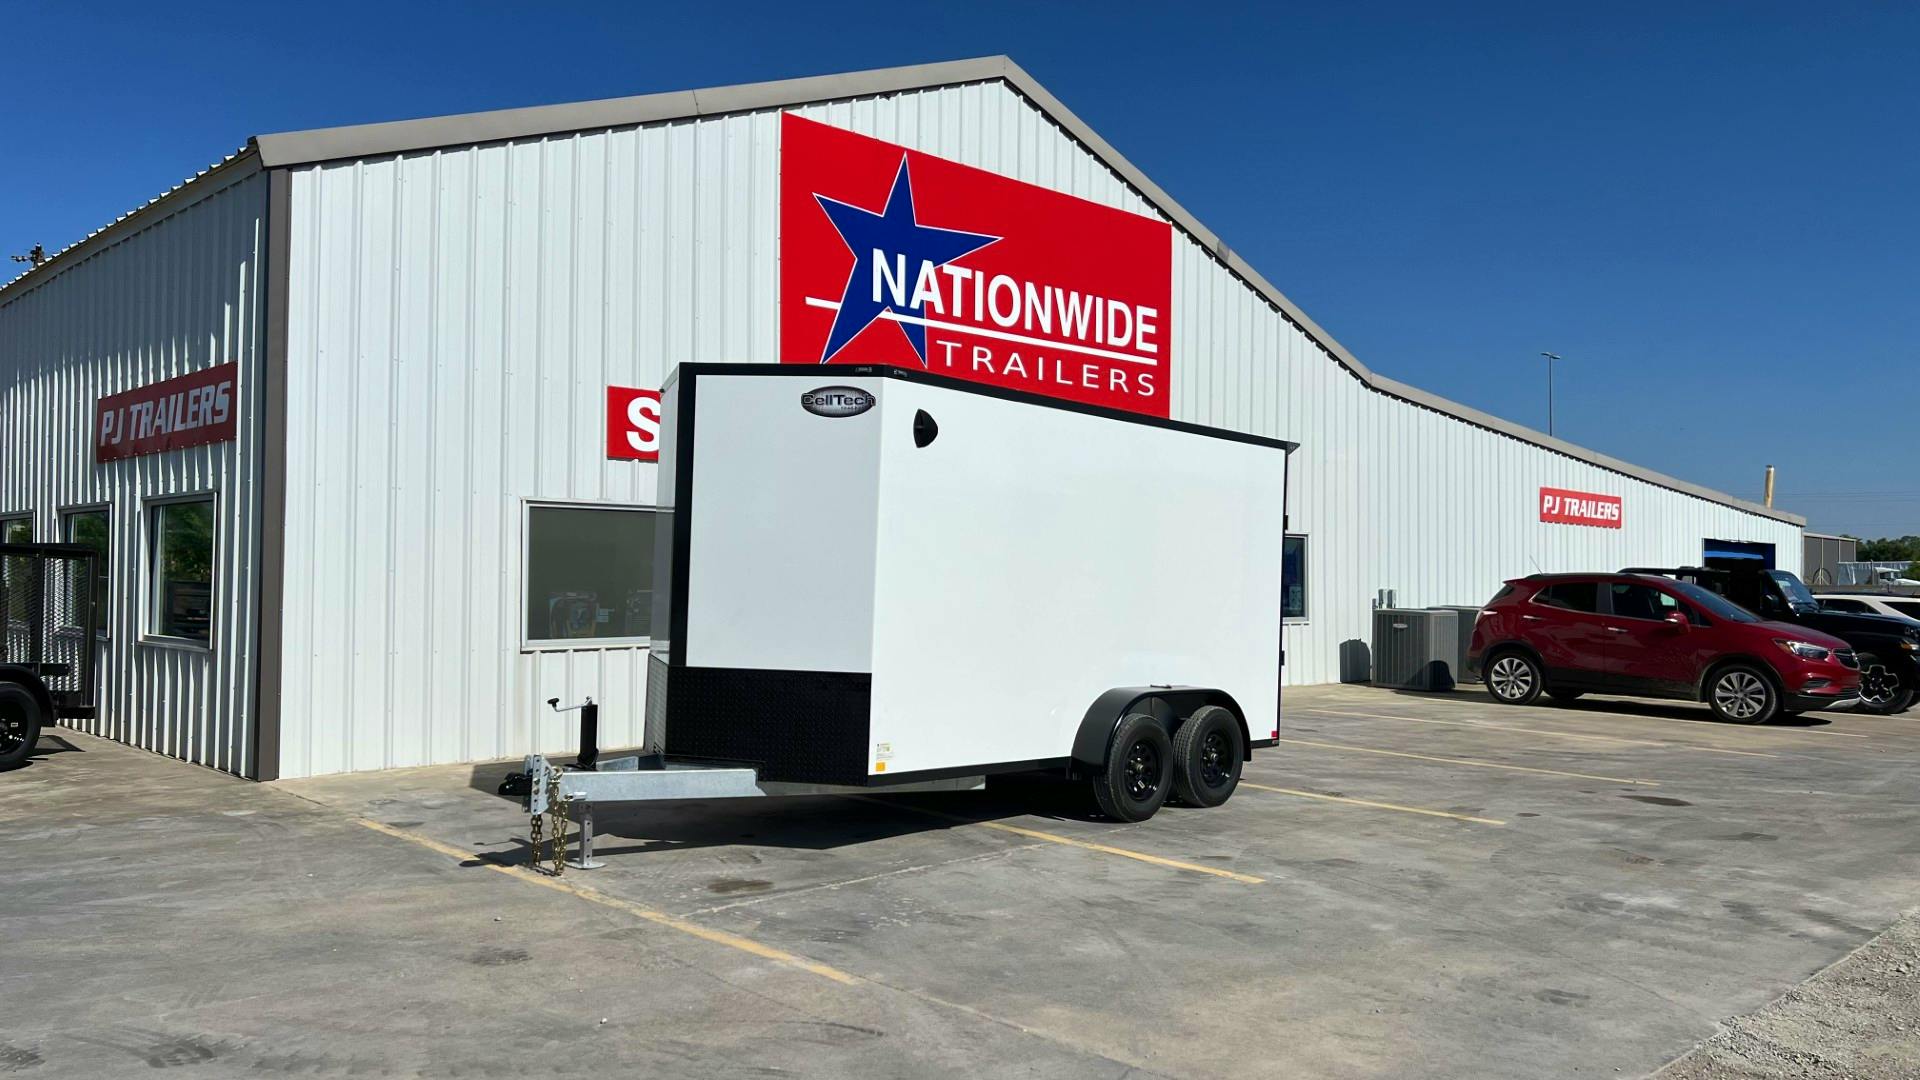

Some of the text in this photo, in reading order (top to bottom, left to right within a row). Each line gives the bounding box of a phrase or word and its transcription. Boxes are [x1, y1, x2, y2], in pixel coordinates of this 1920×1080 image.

[872, 247, 1158, 353] NATIONWIDE
[936, 339, 1155, 397] TRAILERS
[100, 380, 232, 447] PJ TRAILERS
[800, 392, 877, 406] CellTech
[1543, 495, 1620, 521] PJ TRAILERS
